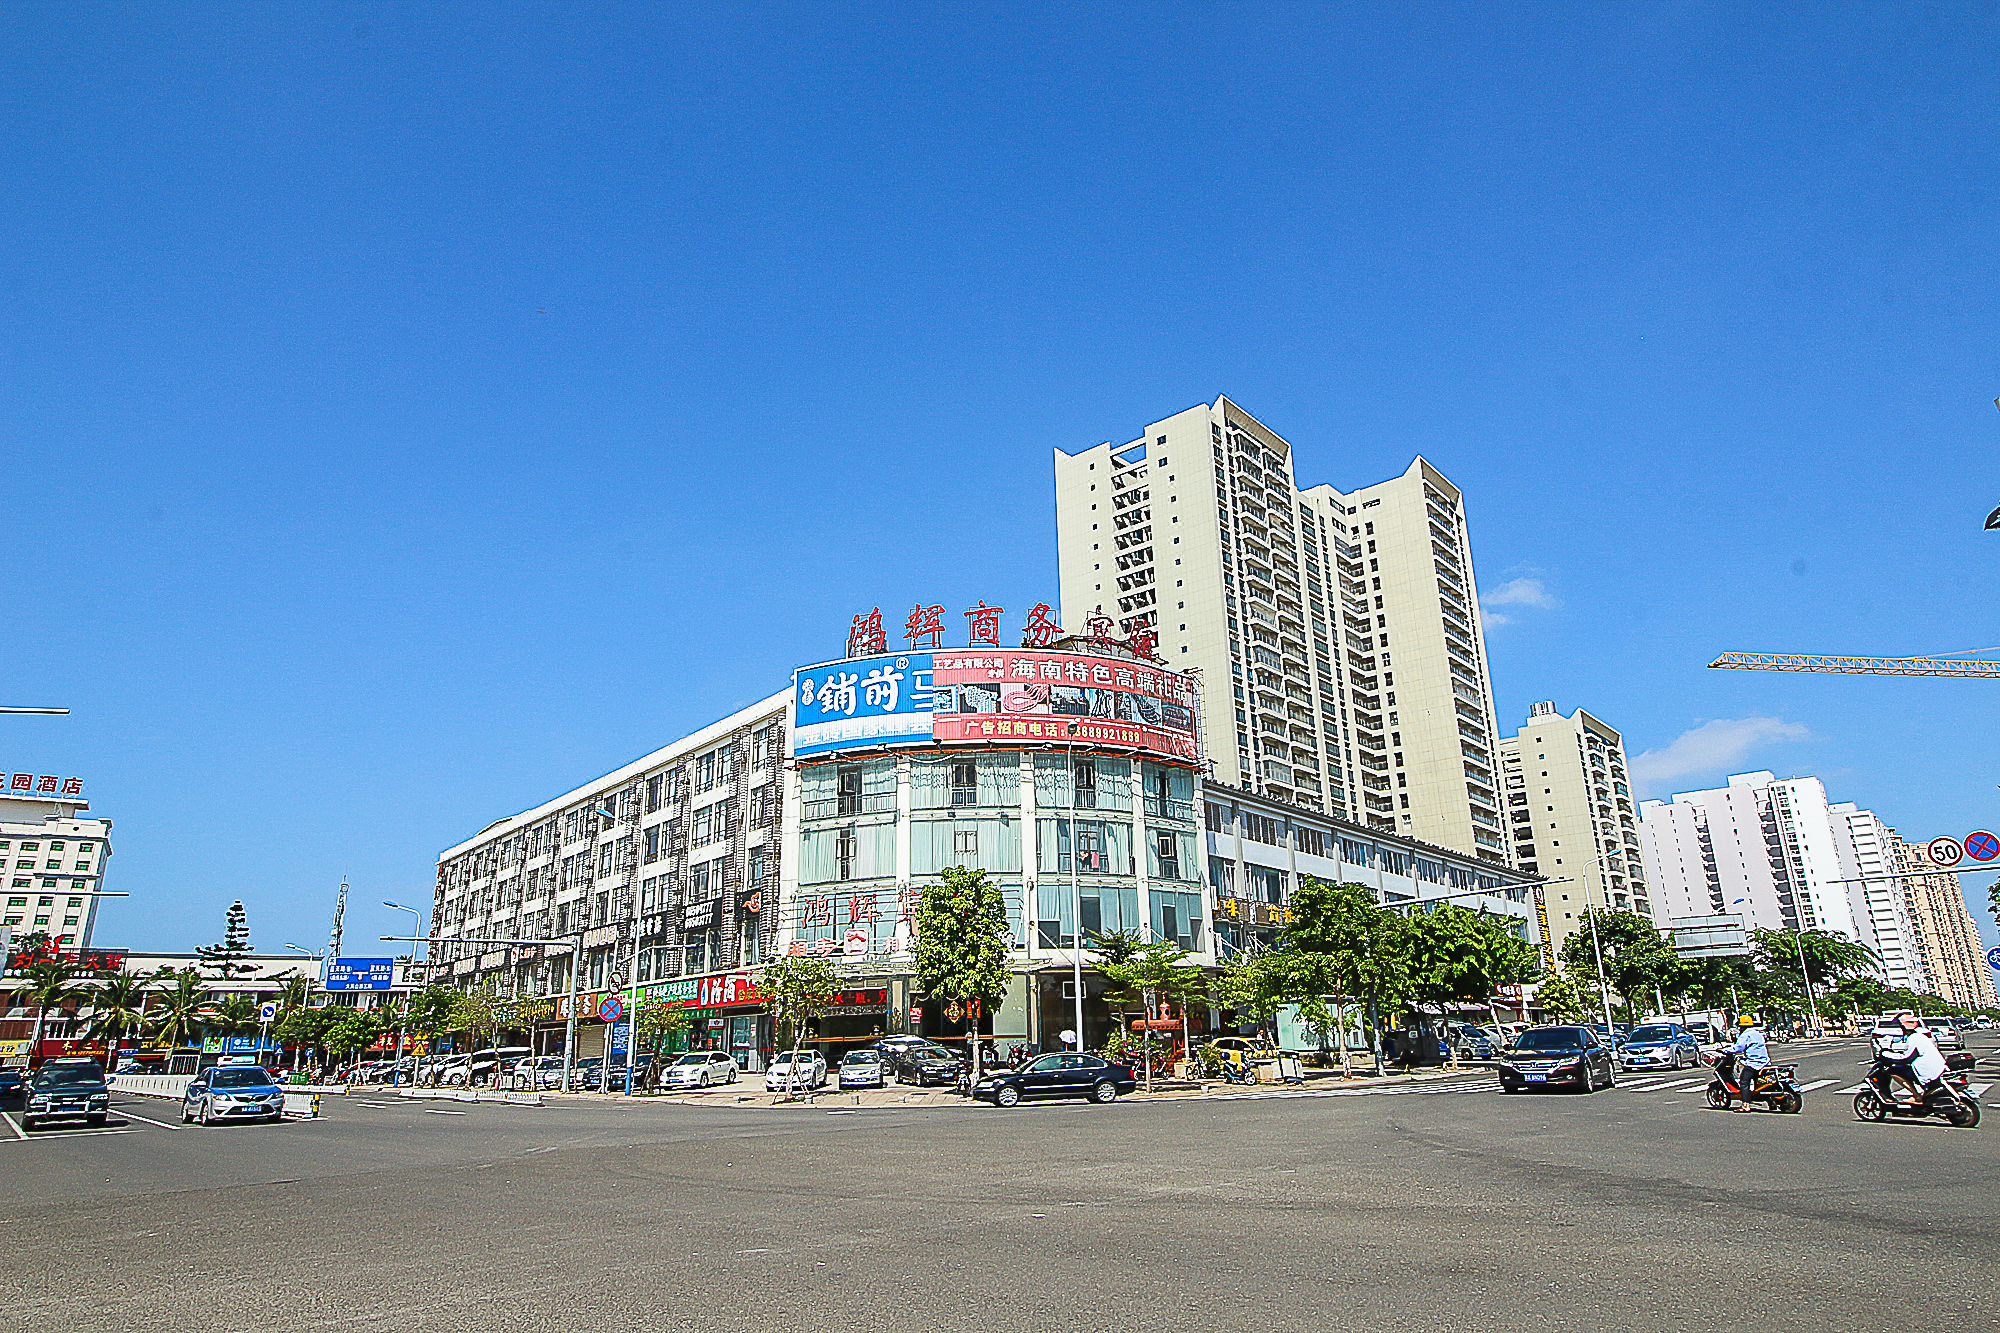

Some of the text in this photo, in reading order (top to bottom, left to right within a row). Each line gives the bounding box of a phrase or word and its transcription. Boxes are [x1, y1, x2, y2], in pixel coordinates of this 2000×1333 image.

[1010, 658, 1188, 700] 海南特色高端礼品
[1934, 844, 1958, 861] 50
